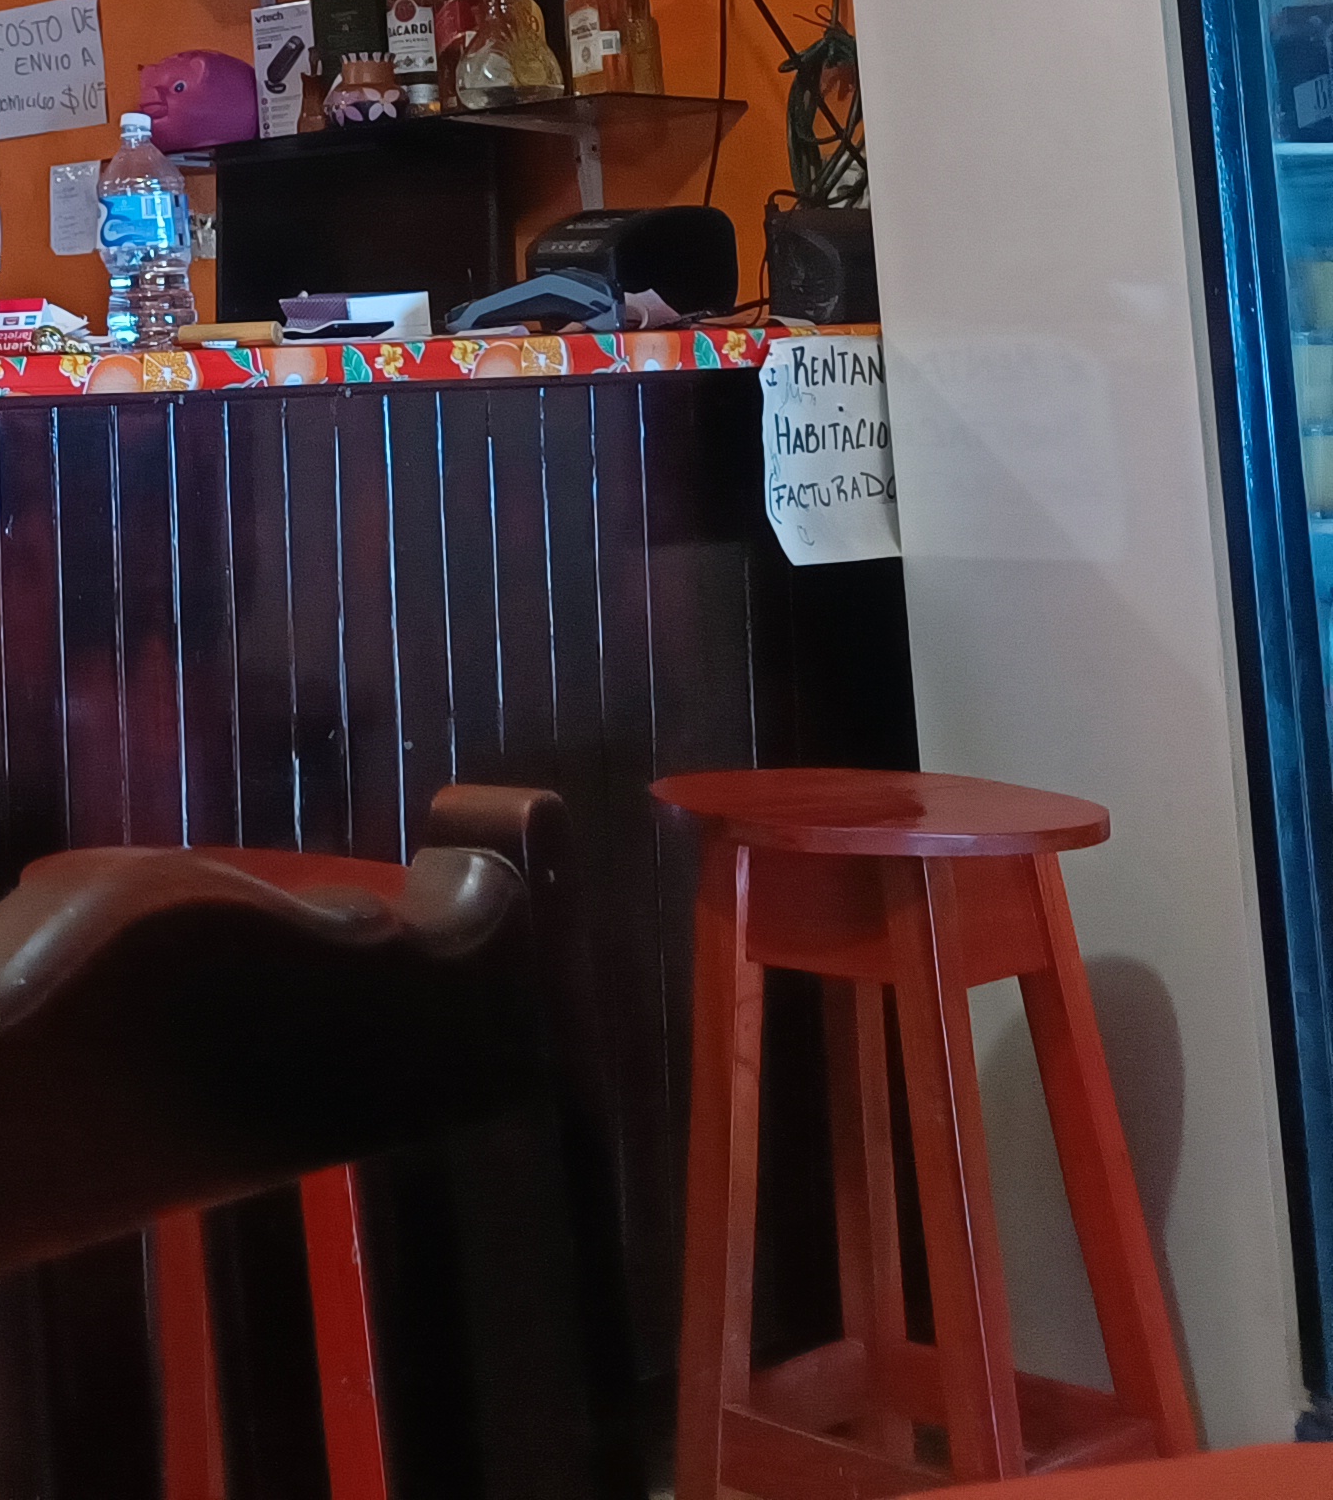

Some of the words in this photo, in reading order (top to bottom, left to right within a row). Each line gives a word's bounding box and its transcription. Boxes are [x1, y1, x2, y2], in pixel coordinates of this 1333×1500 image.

[71, 6, 96, 34] DE
[254, 11, 284, 24] vtech
[14, 51, 71, 76] ENVIO
[81, 46, 96, 67] A
[792, 344, 885, 387] RENTAN
[774, 413, 888, 455] HABITACIO
